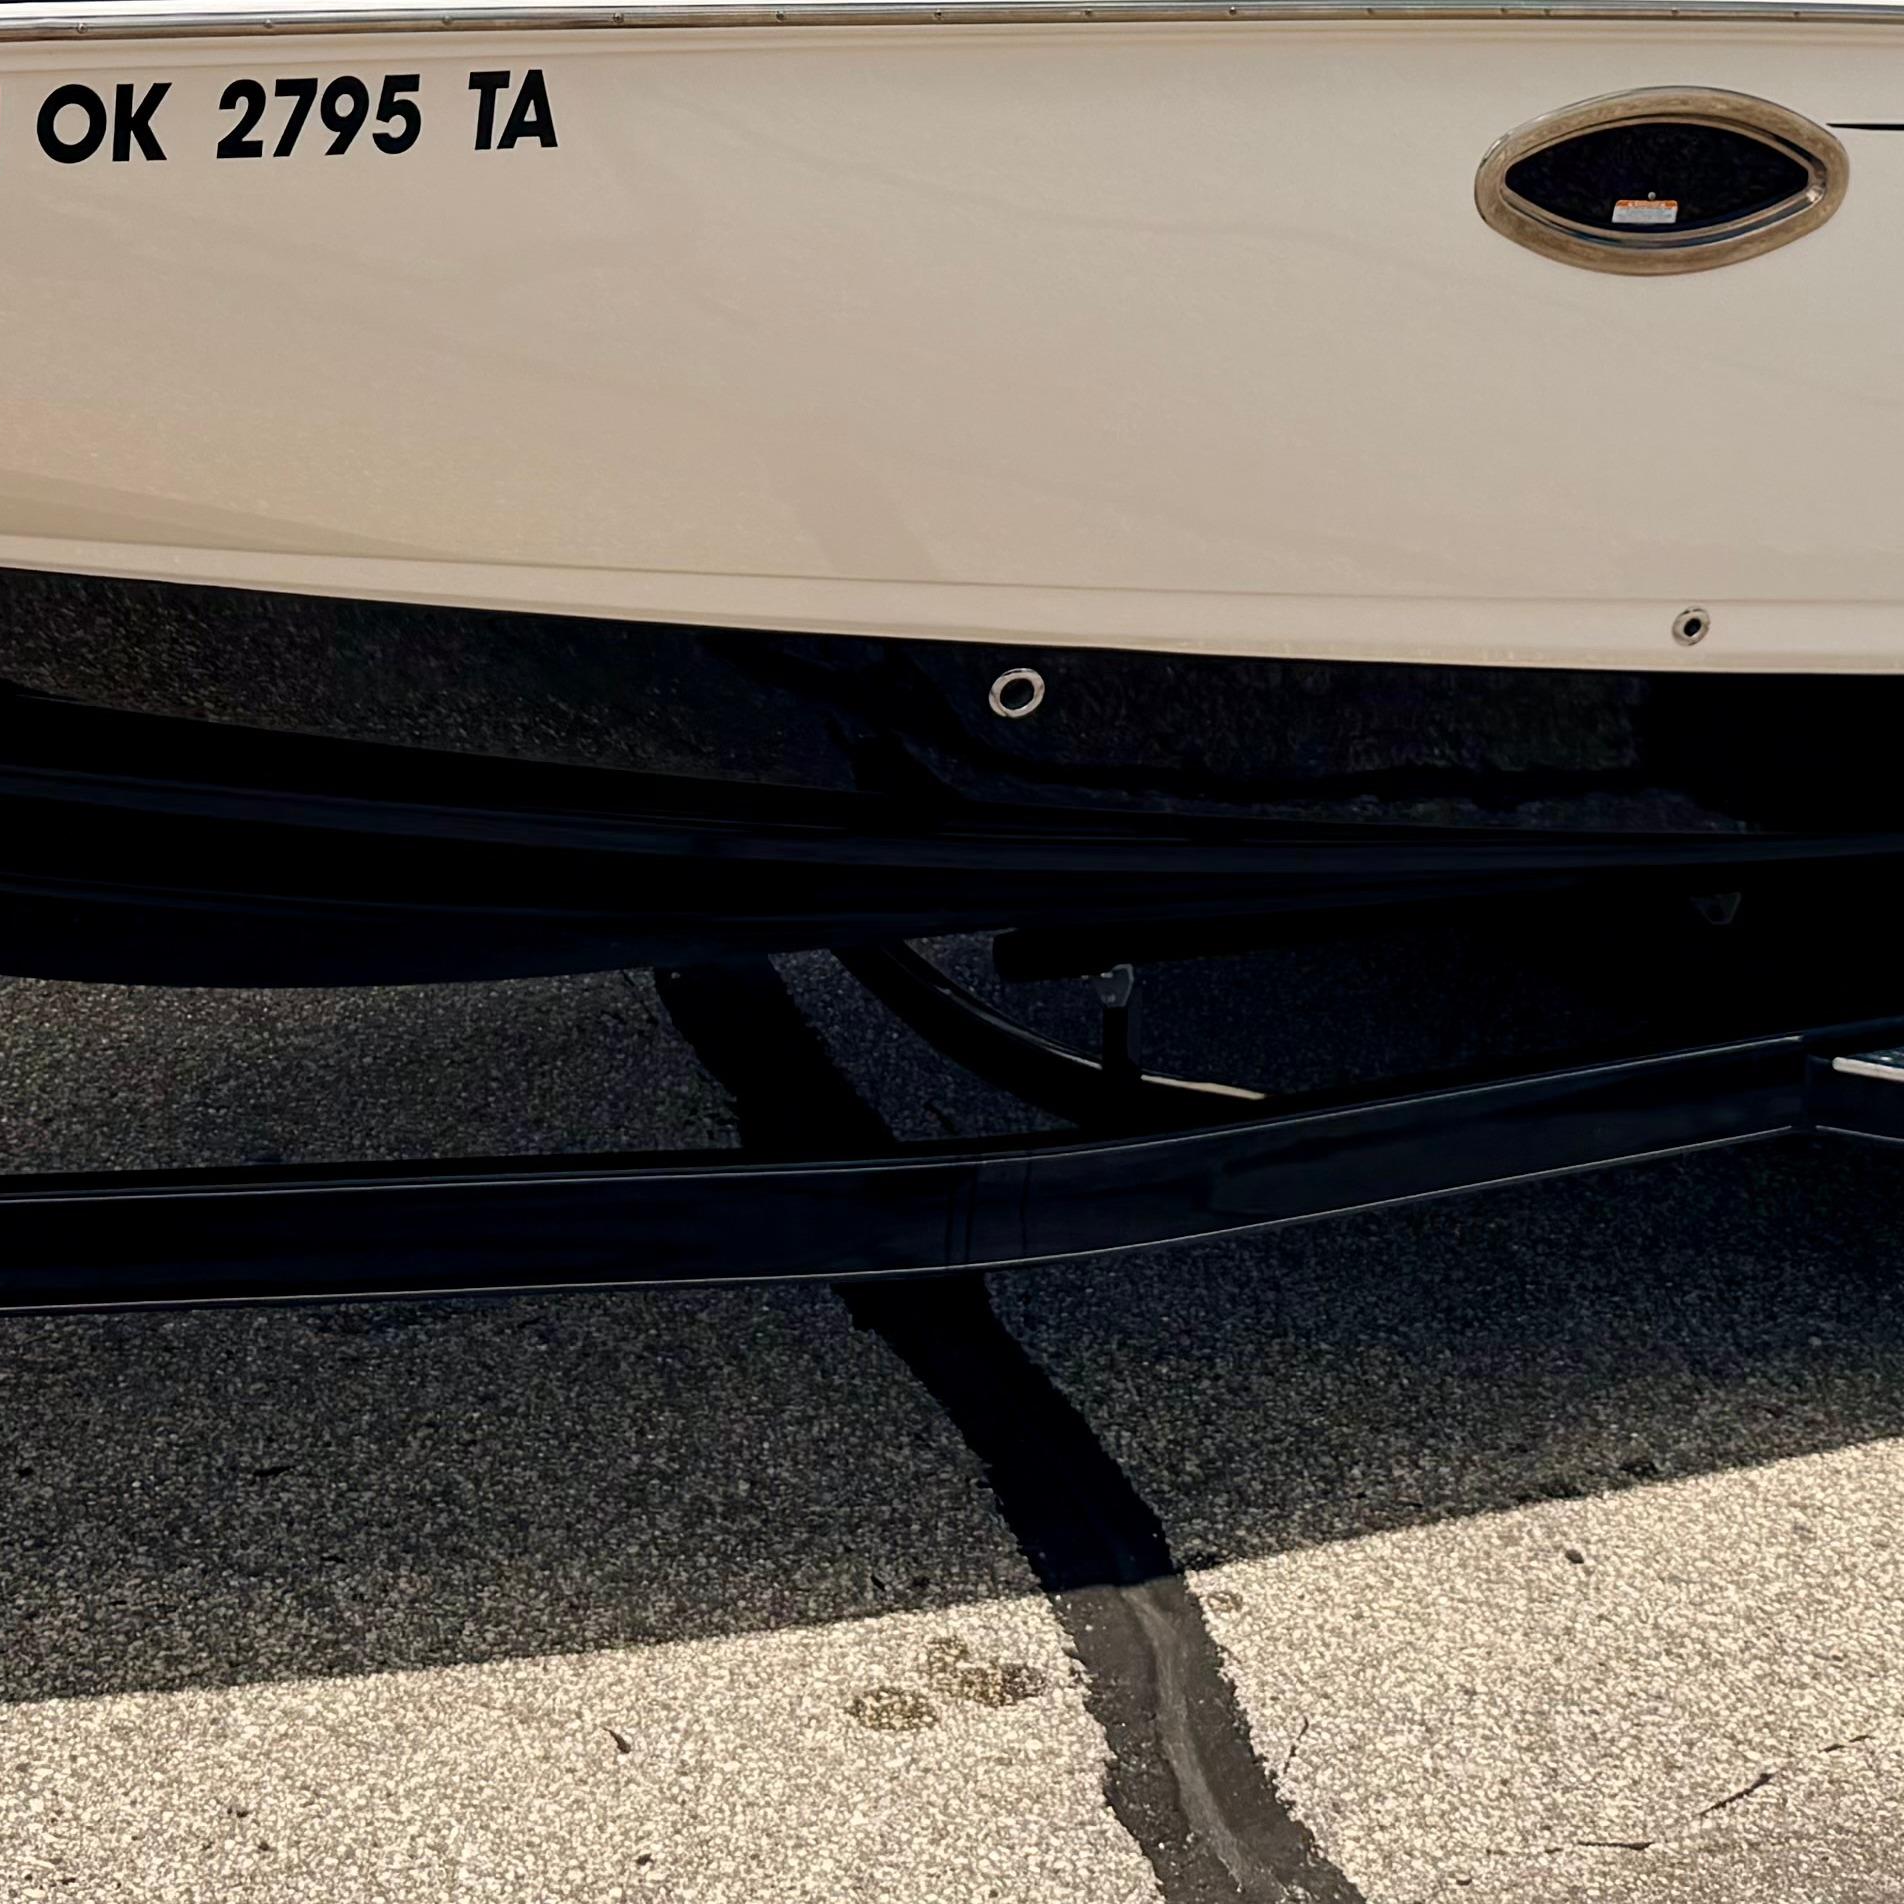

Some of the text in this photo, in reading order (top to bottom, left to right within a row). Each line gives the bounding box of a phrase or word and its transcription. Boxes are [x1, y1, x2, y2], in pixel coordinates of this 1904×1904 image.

[36, 70, 558, 163] OK 2795 TA
